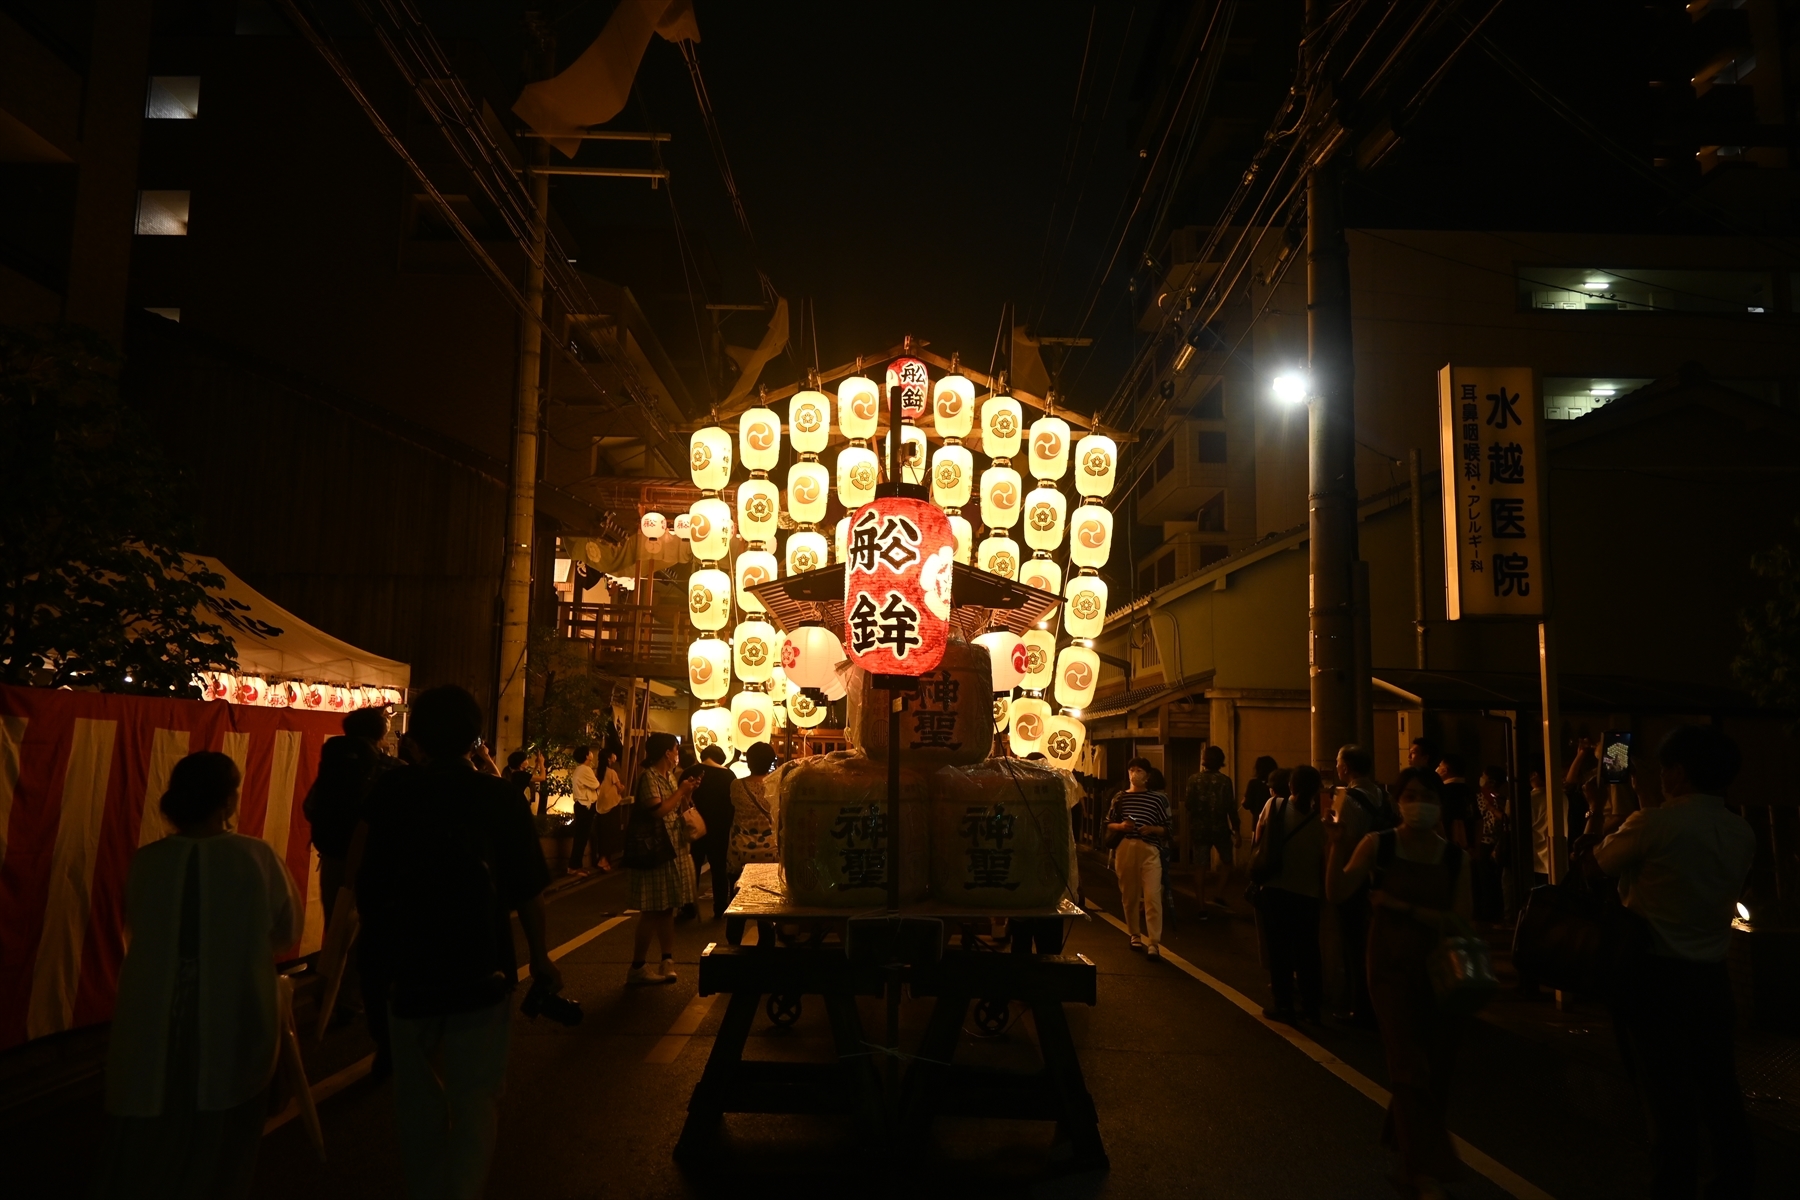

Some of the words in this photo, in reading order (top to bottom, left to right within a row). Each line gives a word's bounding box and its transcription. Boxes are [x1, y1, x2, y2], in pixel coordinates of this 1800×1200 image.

[1461, 384, 1484, 573] 耳鼻咽喉科・アレルギー科
[1486, 387, 1530, 598] 水越医院
[904, 669, 964, 751] 神聖
[830, 802, 889, 892] 神聖
[958, 803, 1021, 892] 神聖
